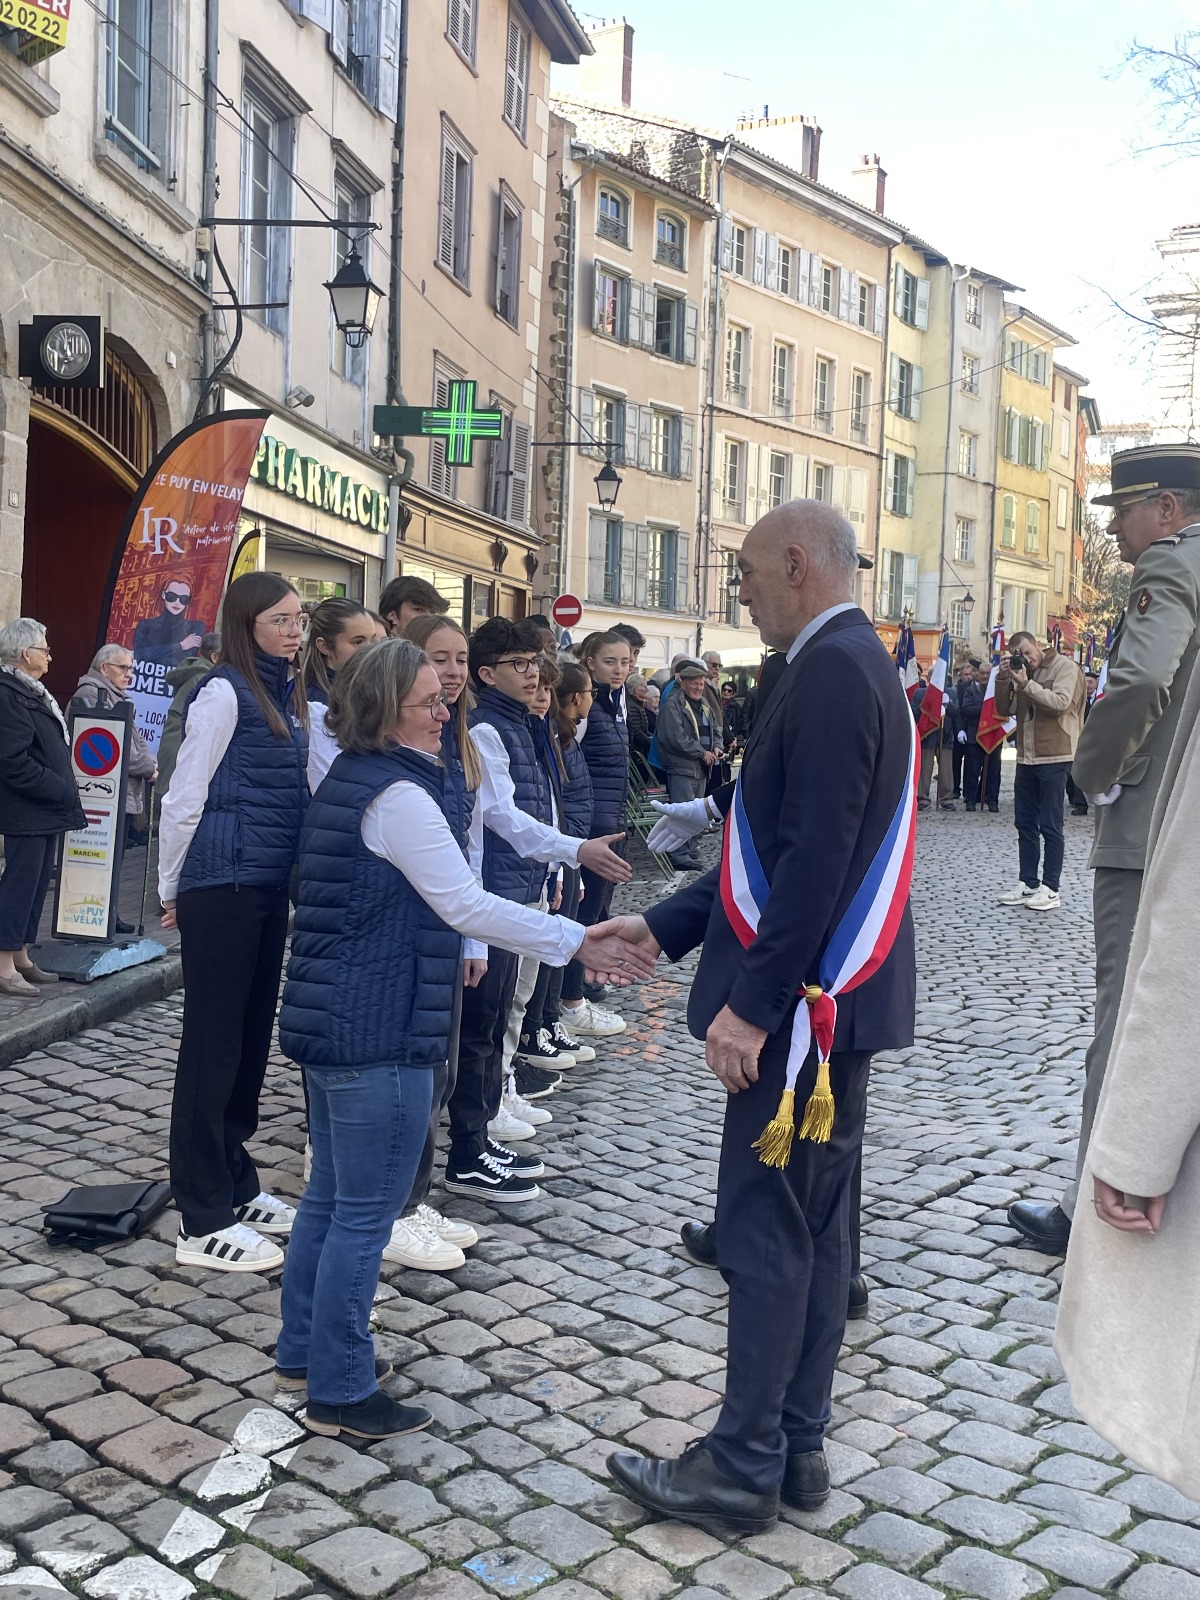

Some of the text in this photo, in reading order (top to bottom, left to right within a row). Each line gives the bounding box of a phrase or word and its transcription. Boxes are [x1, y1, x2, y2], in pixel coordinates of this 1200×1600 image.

[18, 6, 37, 30] 02
[41, 16, 60, 40] 22
[169, 475, 191, 490] PUY
[192, 480, 209, 494] EN
[210, 483, 244, 501] VELAY
[250, 434, 390, 535] PHARMACIE
[73, 849, 101, 858] MARCHE
[73, 914, 104, 925] VELAY
[86, 906, 105, 916] PUY
